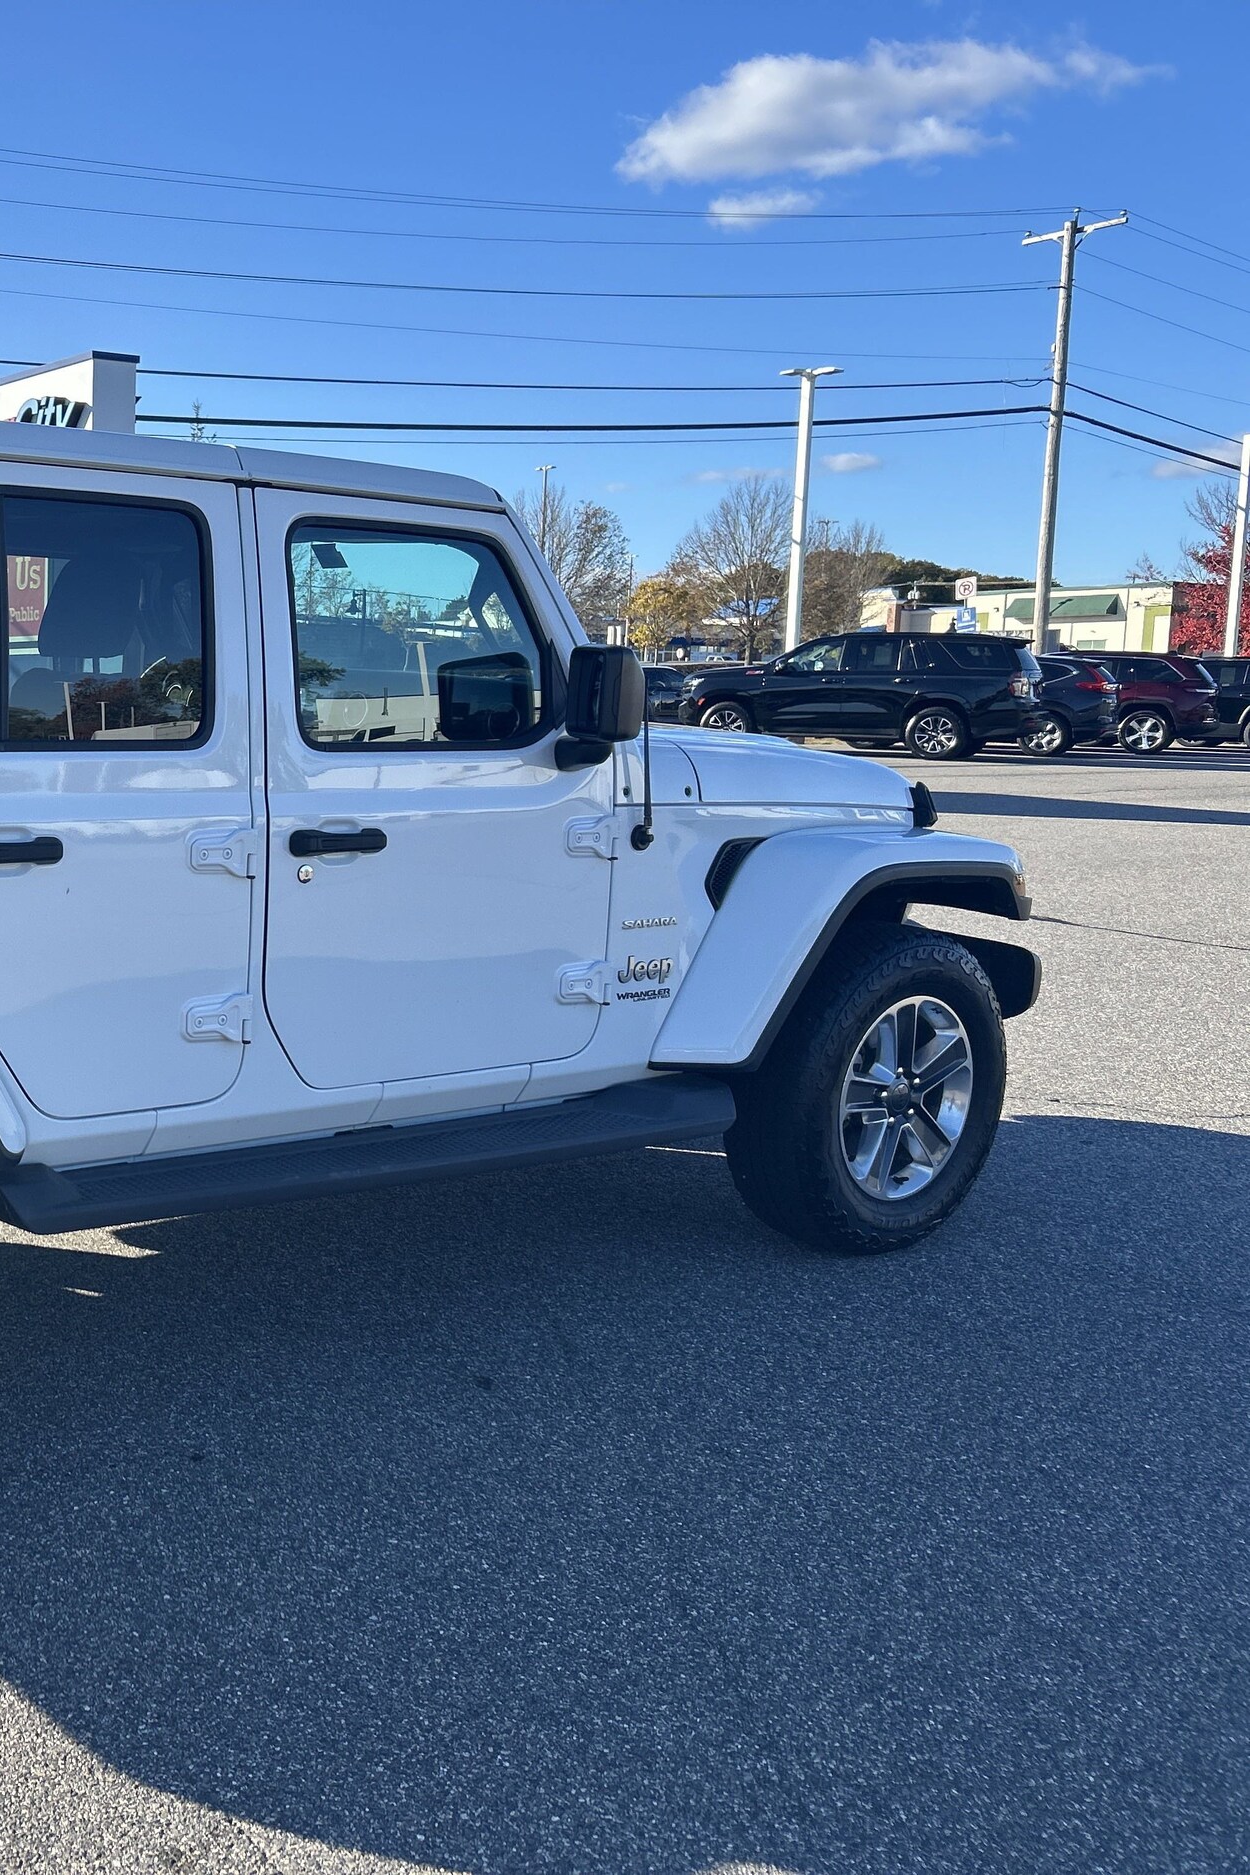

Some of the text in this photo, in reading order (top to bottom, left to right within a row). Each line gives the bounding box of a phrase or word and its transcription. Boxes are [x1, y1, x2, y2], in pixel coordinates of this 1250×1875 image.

[15, 556, 41, 590] Us
[9, 606, 40, 623] Public
[622, 917, 677, 930] SAHARA
[617, 955, 674, 984] Jeep
[616, 988, 671, 1001] WRANGLER
